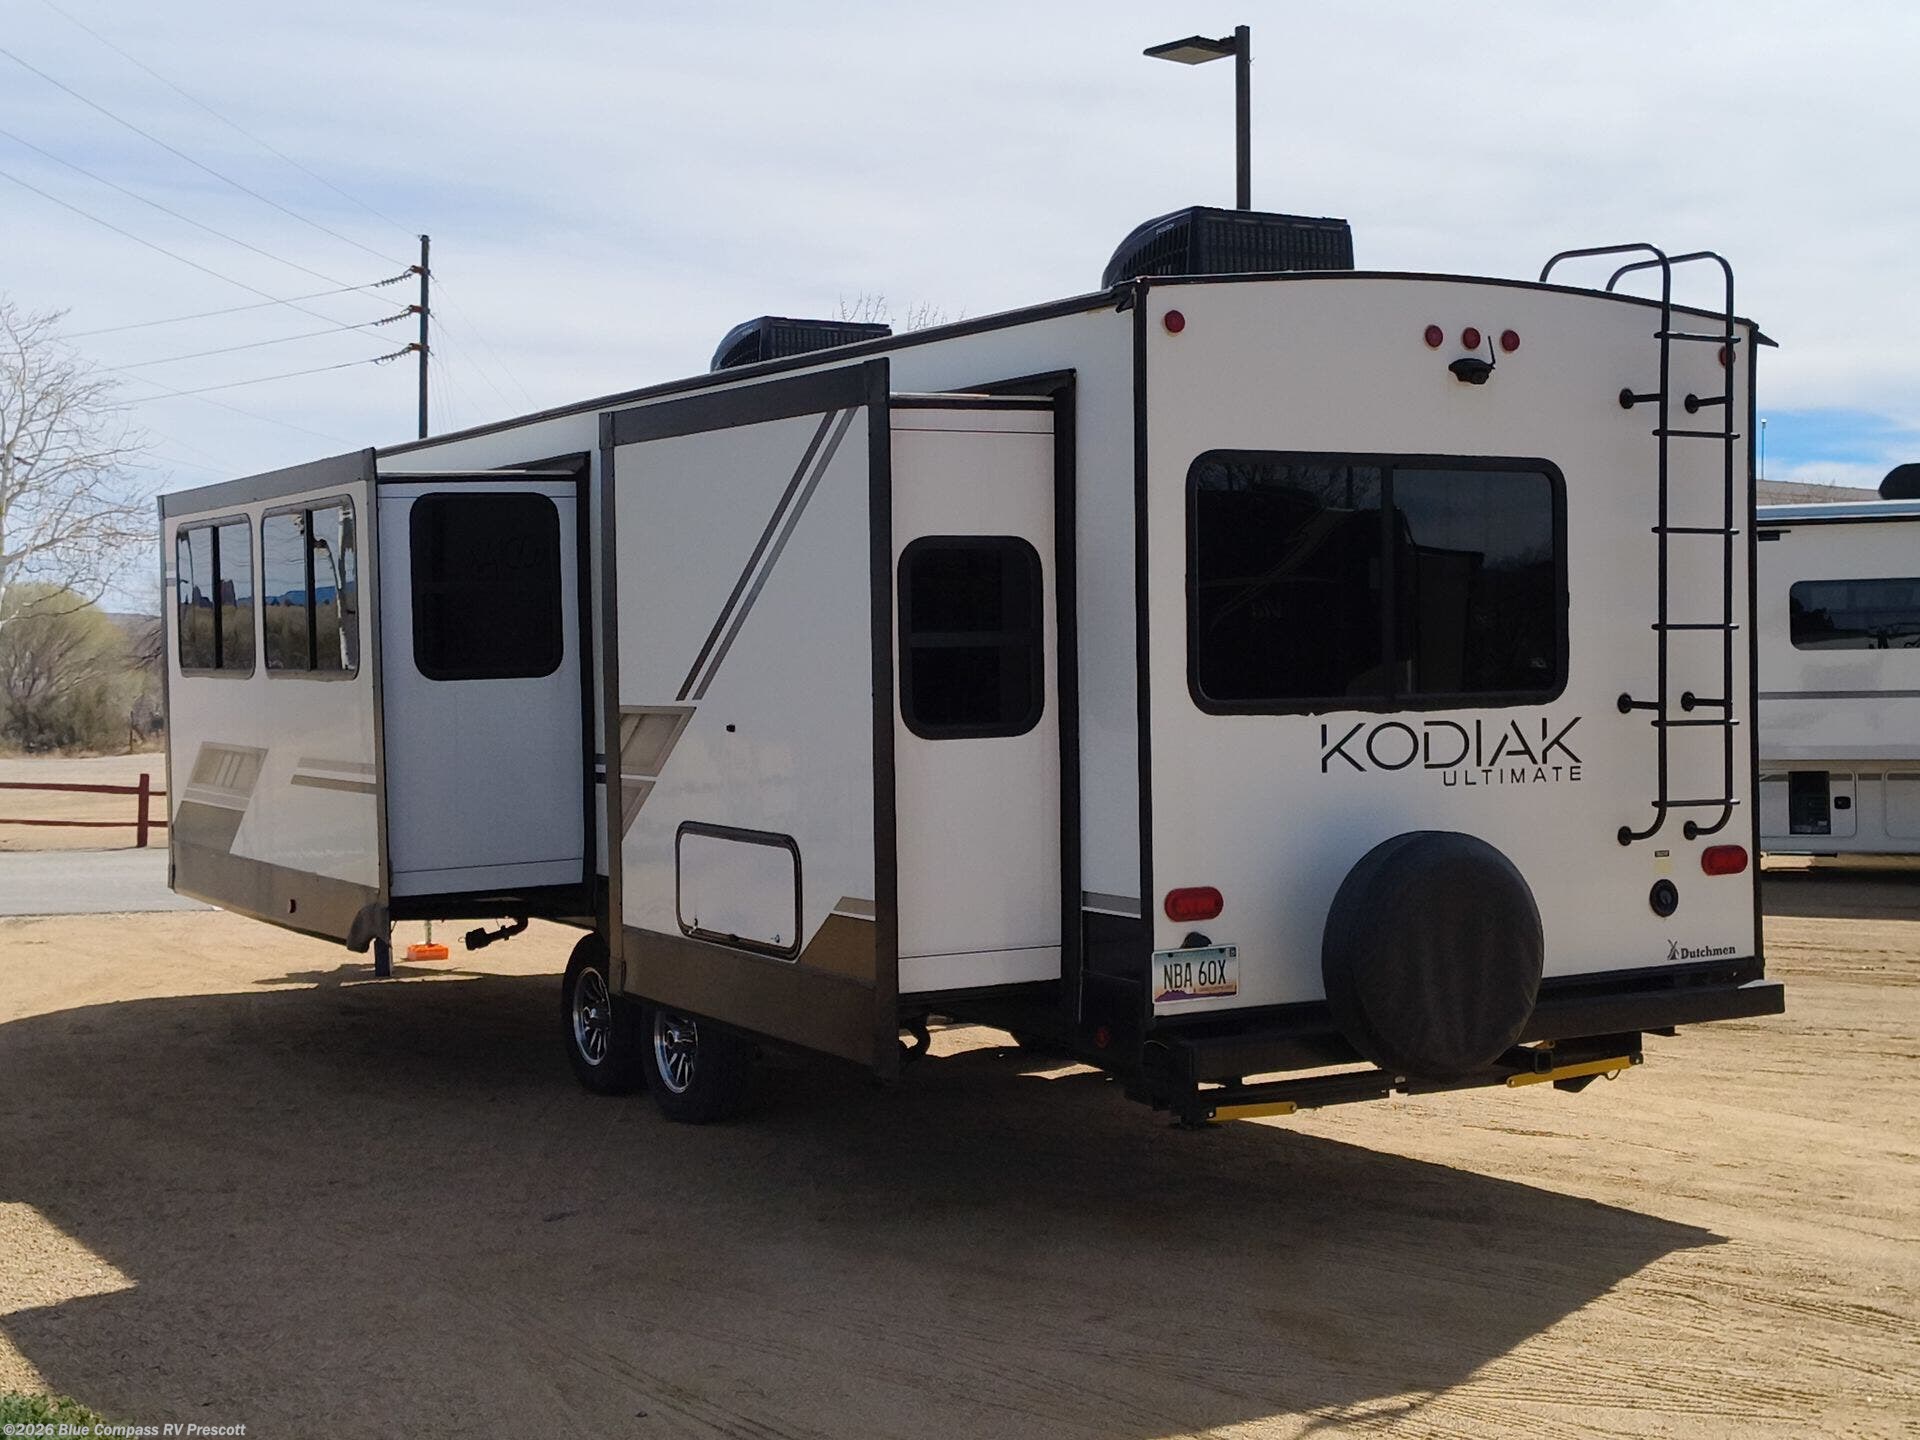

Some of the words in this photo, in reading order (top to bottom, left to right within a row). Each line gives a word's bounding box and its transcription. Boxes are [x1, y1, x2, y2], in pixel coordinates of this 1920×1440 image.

[1321, 716, 1583, 773] KODIAK
[1443, 766, 1582, 786] ULTIMATE
[1680, 945, 1736, 960] Dutchmen
[1163, 962, 1193, 989] NBA
[1198, 959, 1226, 986] 60X
